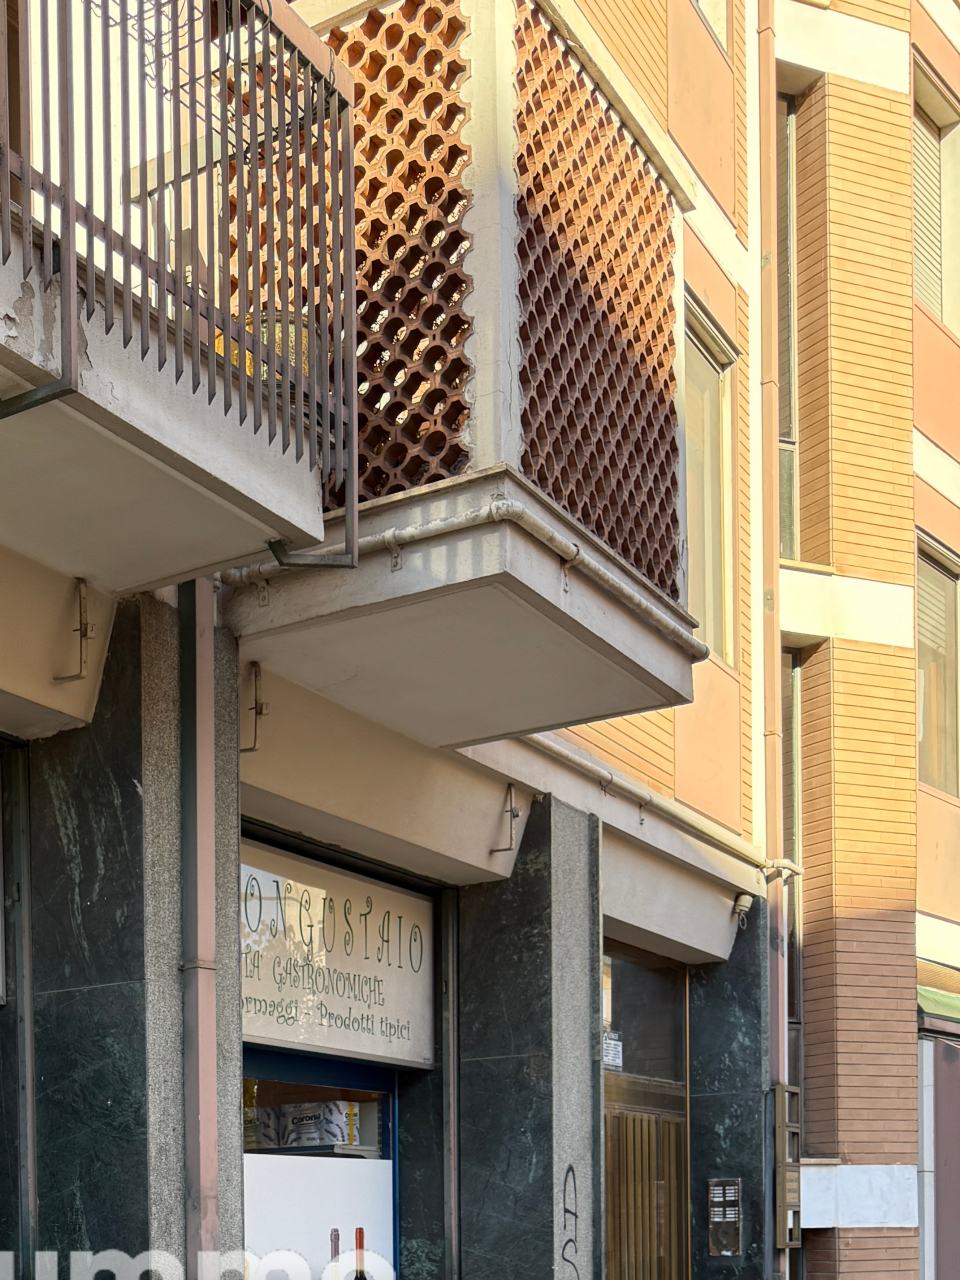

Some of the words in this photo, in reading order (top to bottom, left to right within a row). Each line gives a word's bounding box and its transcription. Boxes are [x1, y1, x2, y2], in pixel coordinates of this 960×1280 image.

[244, 873, 424, 973] ONGUSTAIO
[272, 955, 385, 1009] GASTRONOMICHE
[316, 1000, 375, 1036] Prodotti
[380, 1016, 411, 1043] tipici
[291, 1113, 321, 1126] Corona
